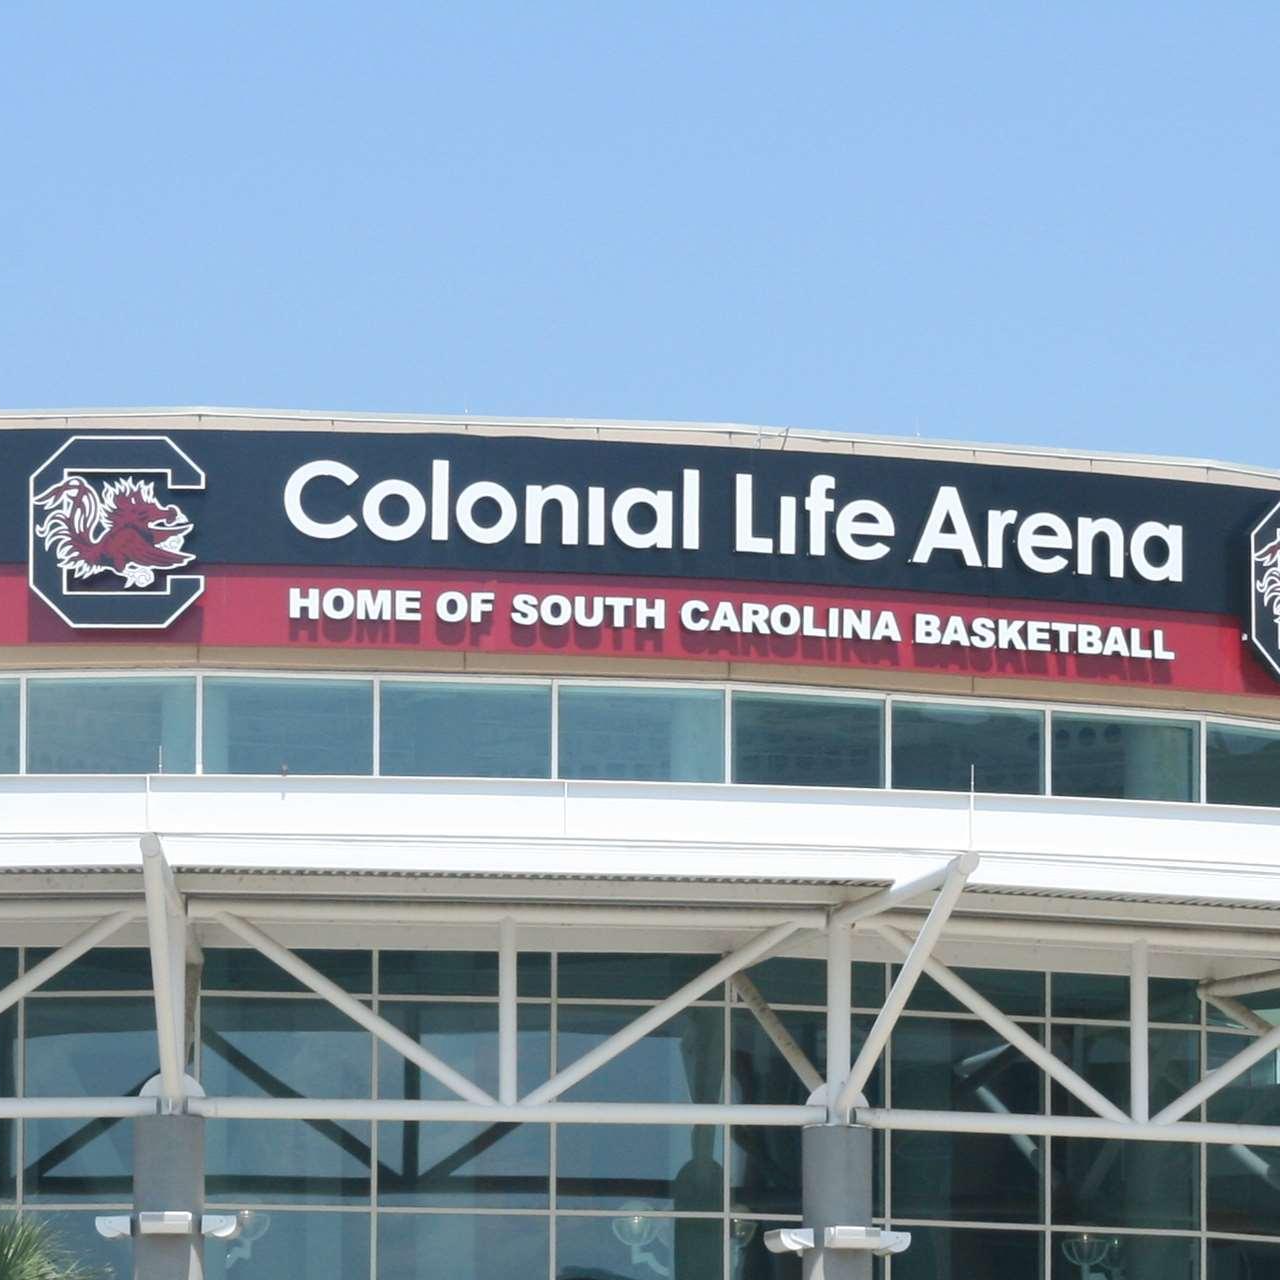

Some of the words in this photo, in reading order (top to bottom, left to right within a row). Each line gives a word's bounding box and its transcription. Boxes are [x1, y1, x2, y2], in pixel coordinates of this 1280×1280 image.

[285, 459, 700, 550] Colonial
[736, 473, 895, 561] Life
[913, 486, 1183, 582] Arena
[289, 587, 422, 621] HOME
[436, 591, 495, 623] OF
[511, 593, 666, 629] SOUTH
[680, 599, 902, 642] CAROLINA
[915, 613, 1175, 660] BASKETBALL
